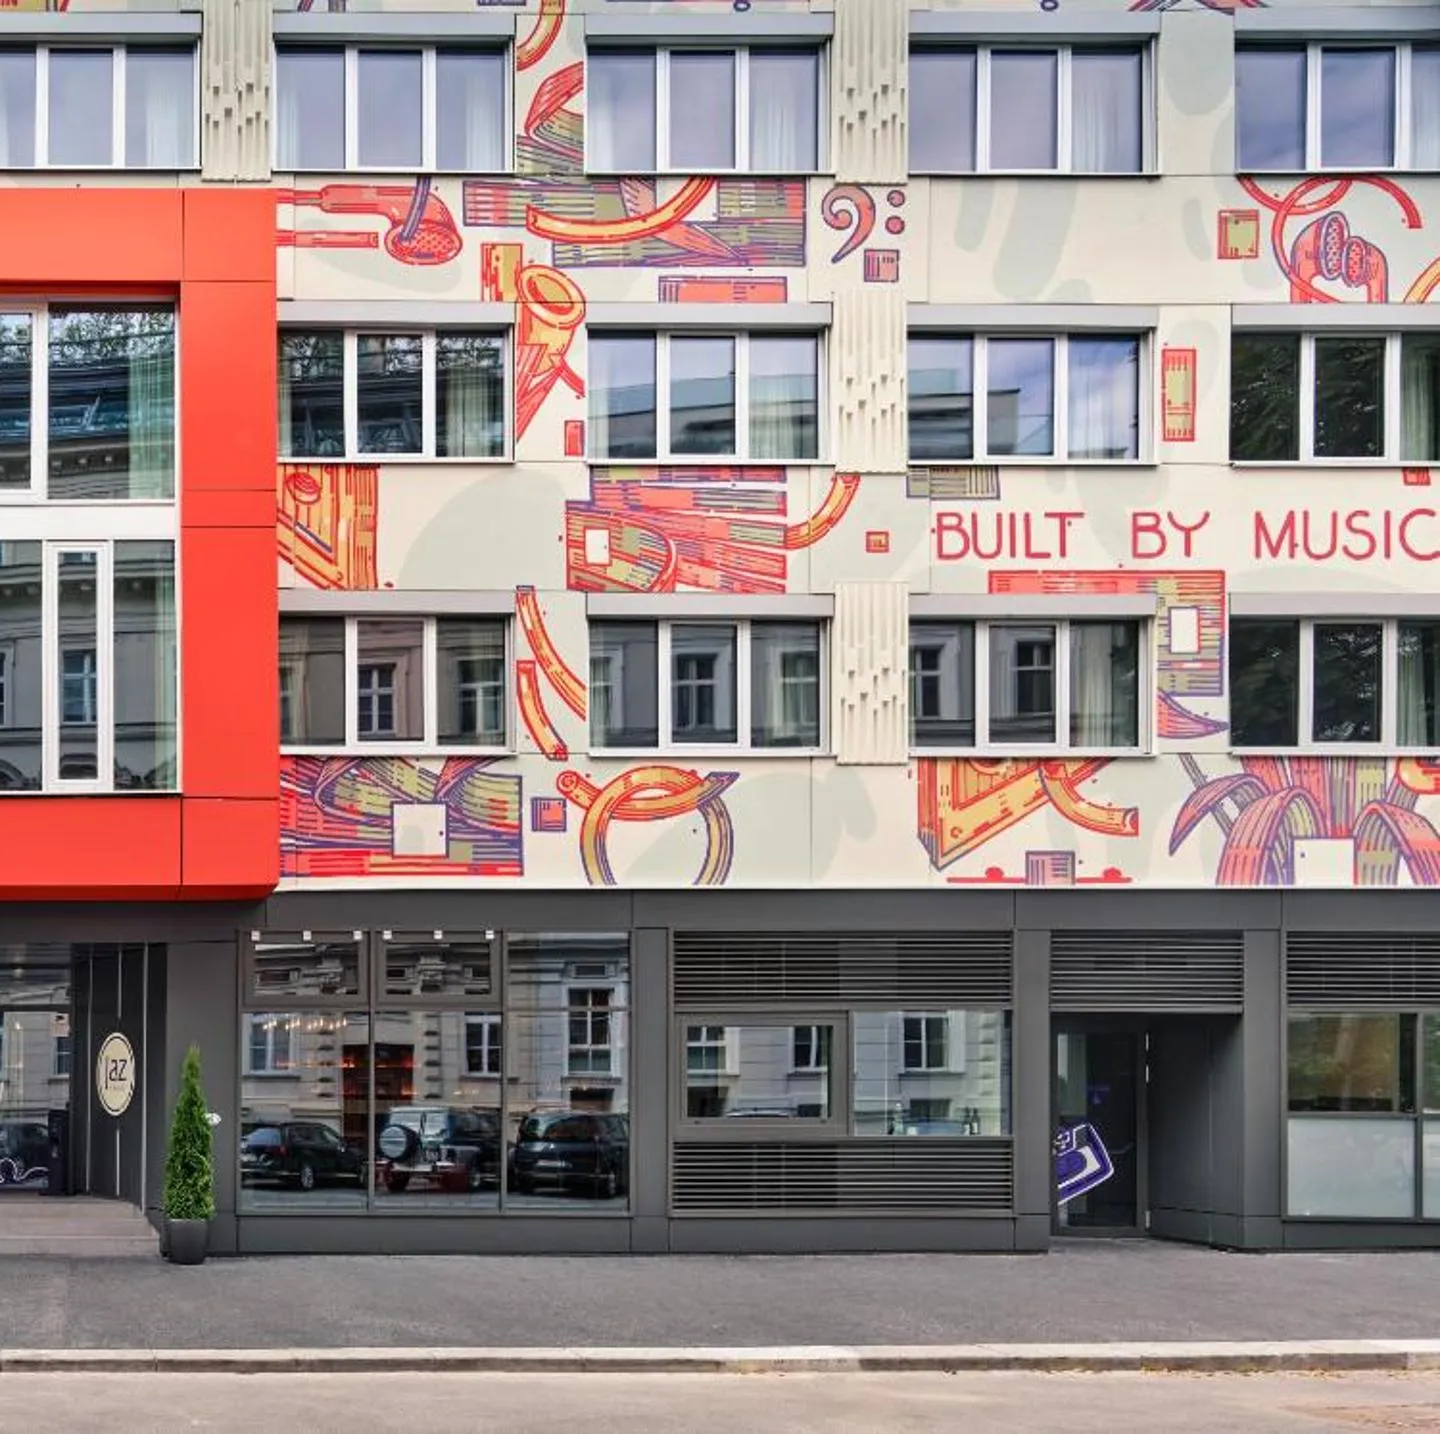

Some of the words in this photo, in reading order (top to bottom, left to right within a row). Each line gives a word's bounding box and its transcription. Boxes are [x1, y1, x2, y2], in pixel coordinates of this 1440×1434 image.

[936, 511, 1086, 560] BUILT
[1131, 511, 1210, 559] BY
[1254, 508, 1440, 561] MUSIC
